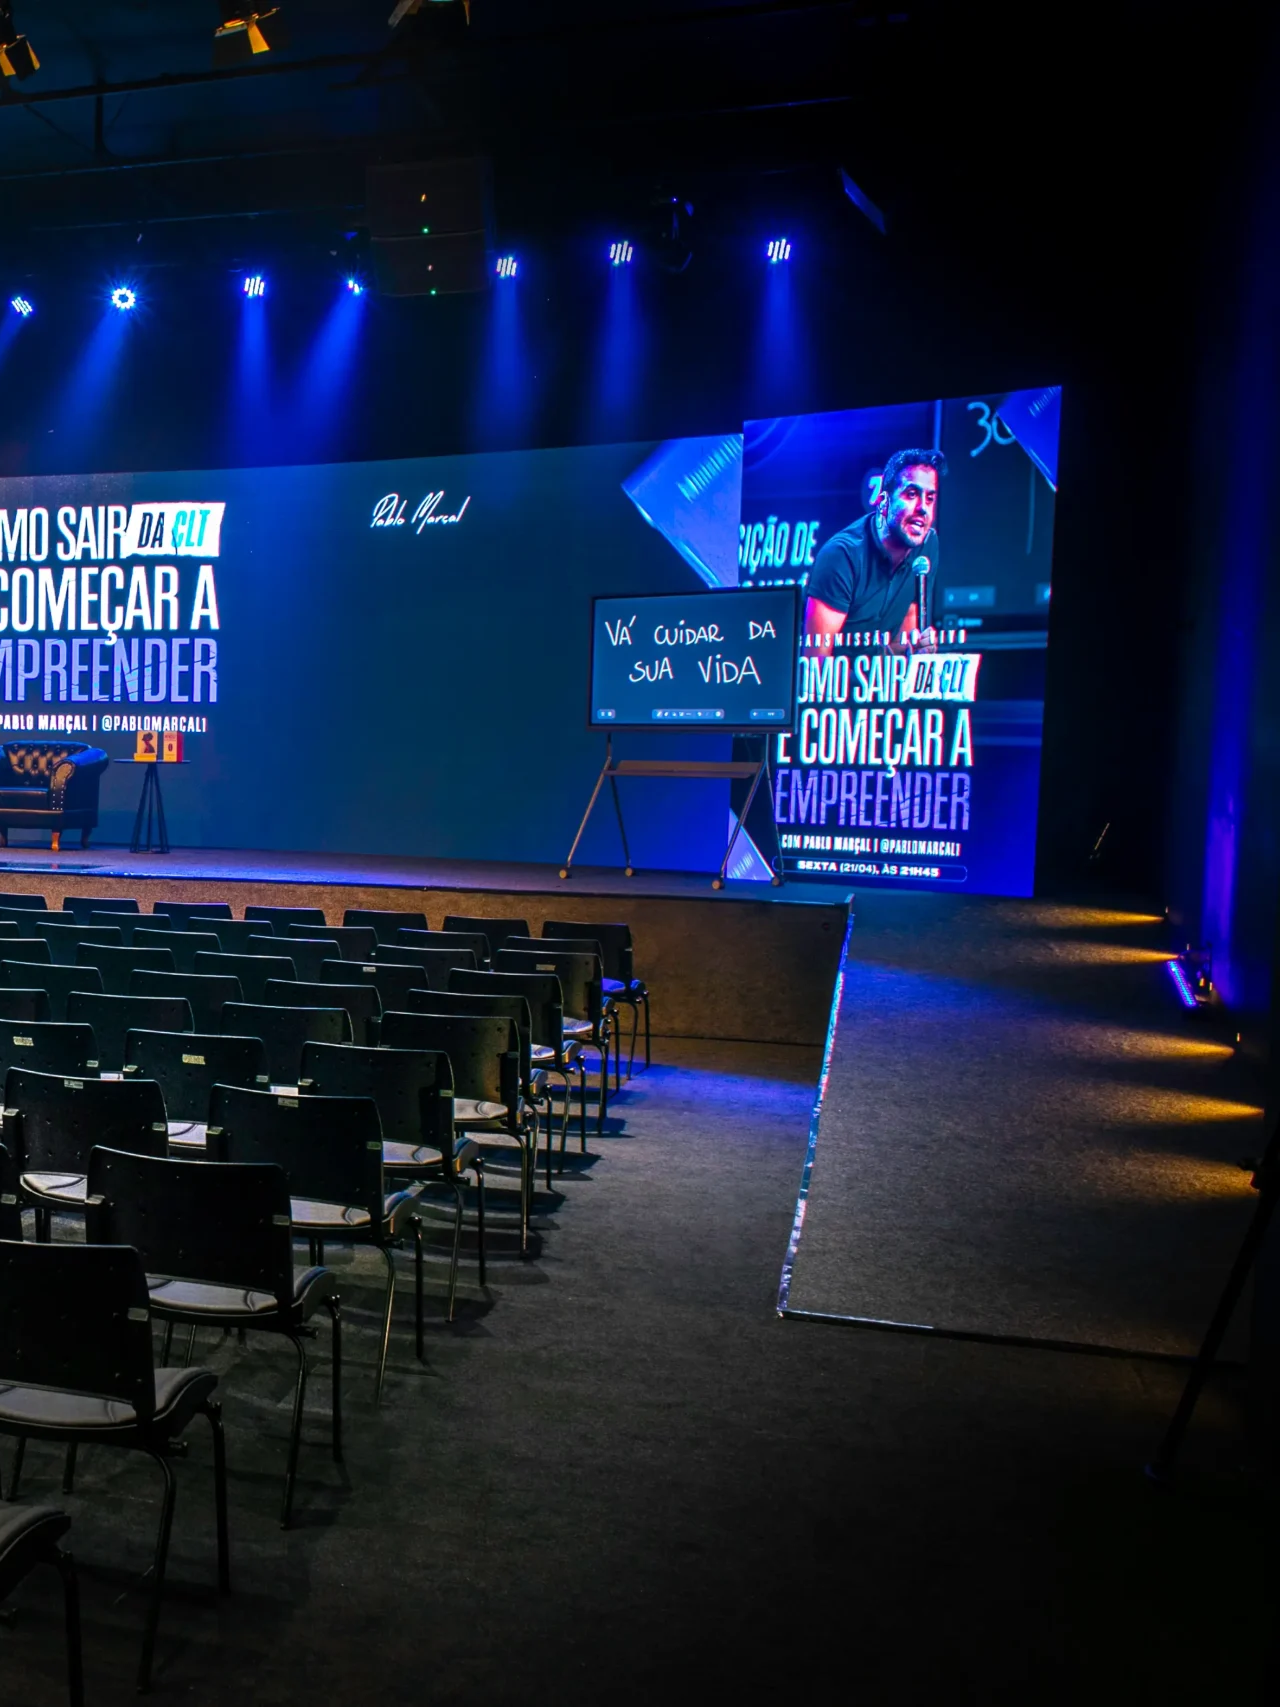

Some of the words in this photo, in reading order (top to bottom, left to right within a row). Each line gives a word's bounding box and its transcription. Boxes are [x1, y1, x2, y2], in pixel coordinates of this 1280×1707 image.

[56, 505, 128, 561] SAIR
[137, 512, 165, 548] DA
[171, 510, 210, 548] CLT
[790, 521, 820, 567] DE
[190, 565, 220, 631] A
[605, 615, 637, 646] VÁ
[749, 620, 776, 640] DA
[799, 630, 890, 647] ANSMISSÃO
[629, 657, 674, 683] SUA
[797, 656, 850, 703] OMO
[853, 655, 907, 702] SAIR
[916, 661, 935, 694] DA
[940, 660, 970, 693] CLT
[38, 715, 87, 733] MARÇAL
[800, 708, 945, 778] COMEÇAR
[950, 709, 973, 766] A
[775, 769, 970, 830] EMPREENDER
[781, 835, 801, 848] COM
[803, 835, 831, 850] PABLO
[834, 836, 871, 854] MARÇAL
[797, 860, 837, 871] SEXTA
[840, 862, 879, 874] (21/04),
[882, 863, 899, 875] ÀS
[900, 866, 940, 877] 21H45
